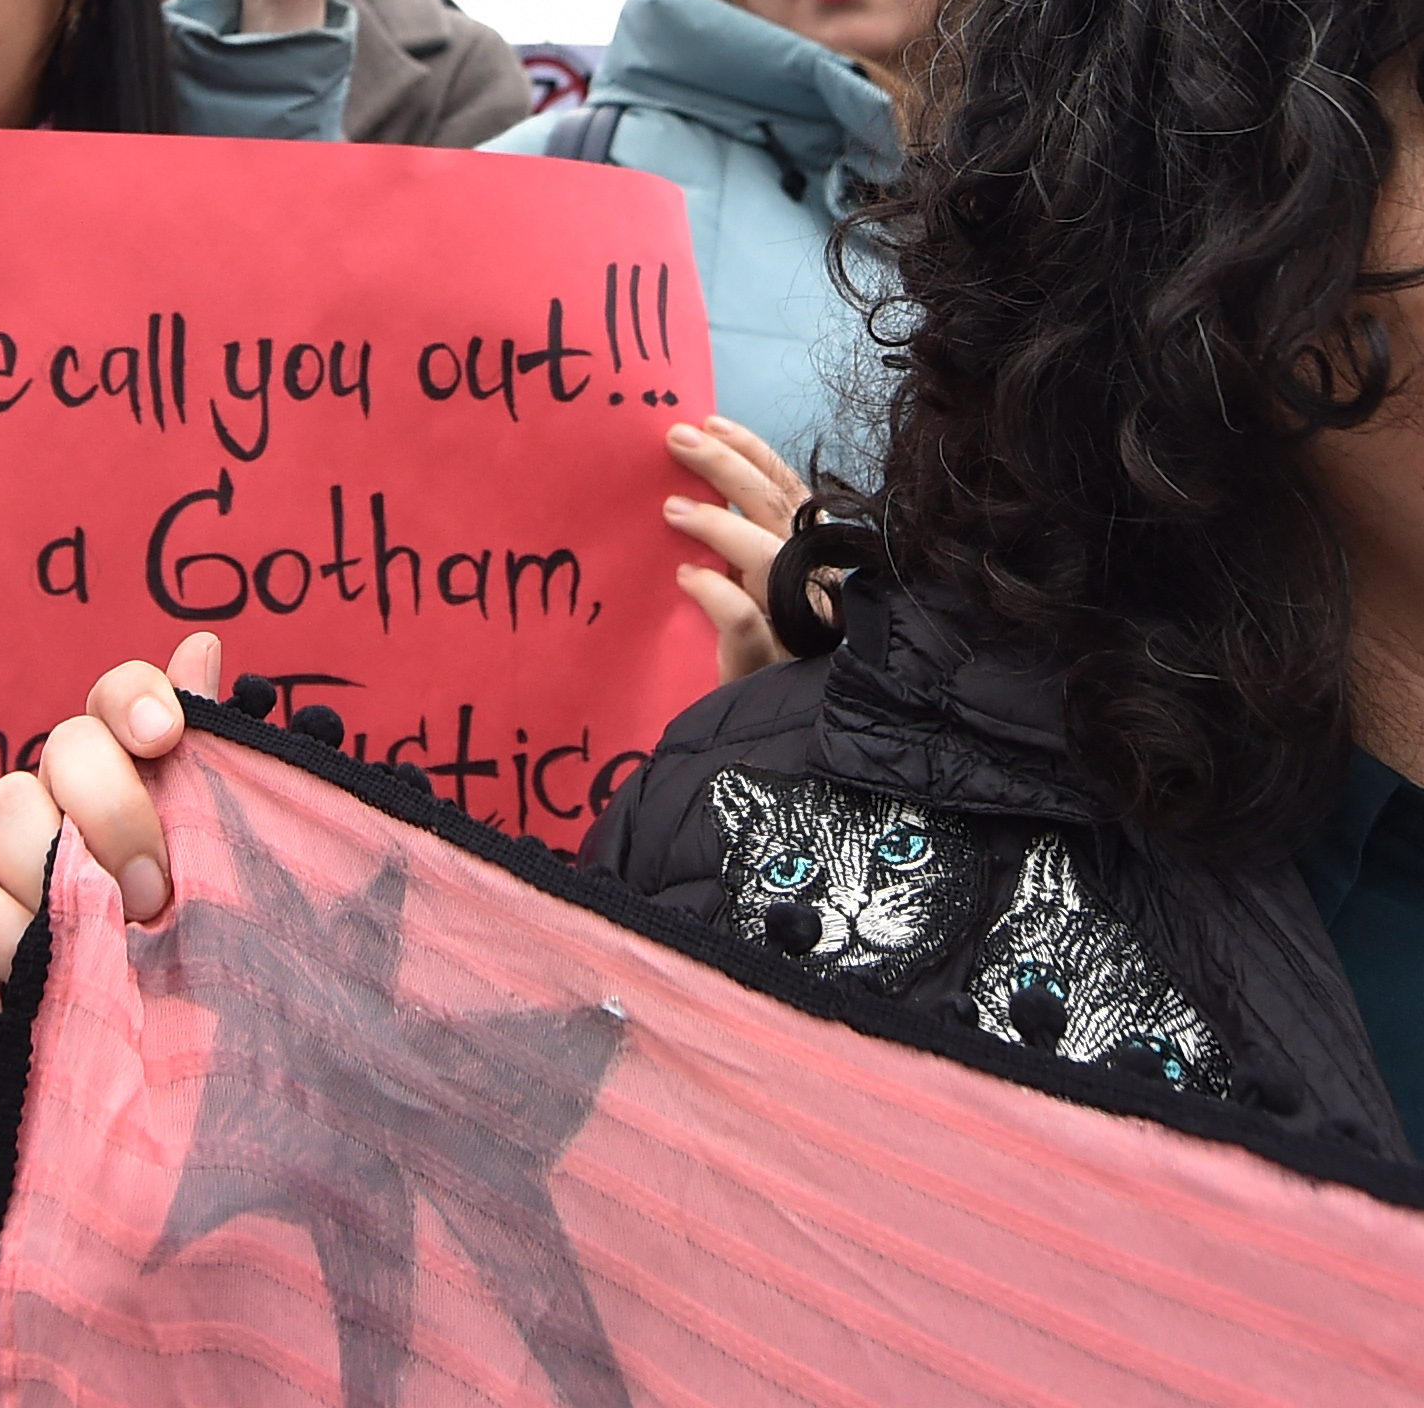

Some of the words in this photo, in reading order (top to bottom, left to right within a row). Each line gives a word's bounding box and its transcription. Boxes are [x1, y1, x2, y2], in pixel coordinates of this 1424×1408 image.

[50, 312, 187, 433] call
[210, 335, 372, 461] you
[36, 526, 88, 604] a
[146, 467, 602, 632] Gotham,
